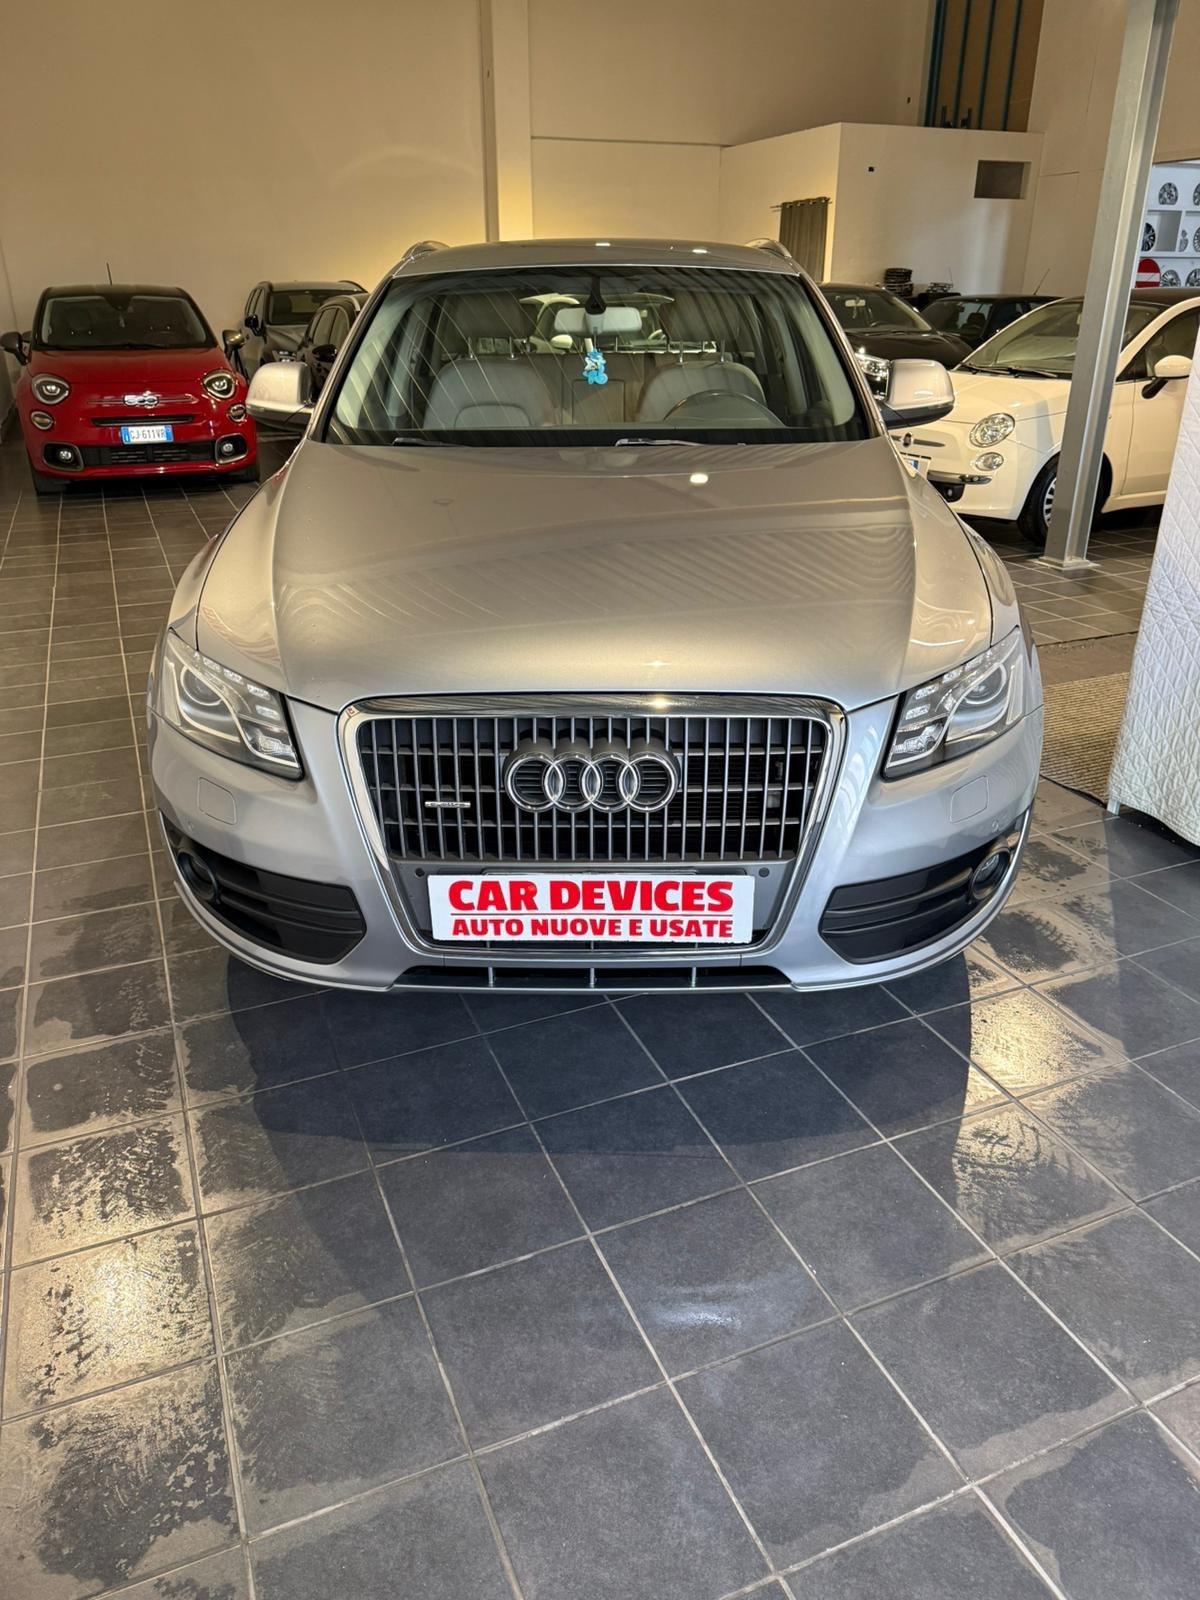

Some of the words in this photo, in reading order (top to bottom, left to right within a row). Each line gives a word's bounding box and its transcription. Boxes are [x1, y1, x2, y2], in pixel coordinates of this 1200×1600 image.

[448, 880, 537, 911] CAR
[550, 880, 733, 912] DEVICES
[452, 918, 523, 936] AUTO
[531, 918, 620, 936] NUOVE
[629, 918, 641, 937] E
[650, 919, 733, 938] USATE
